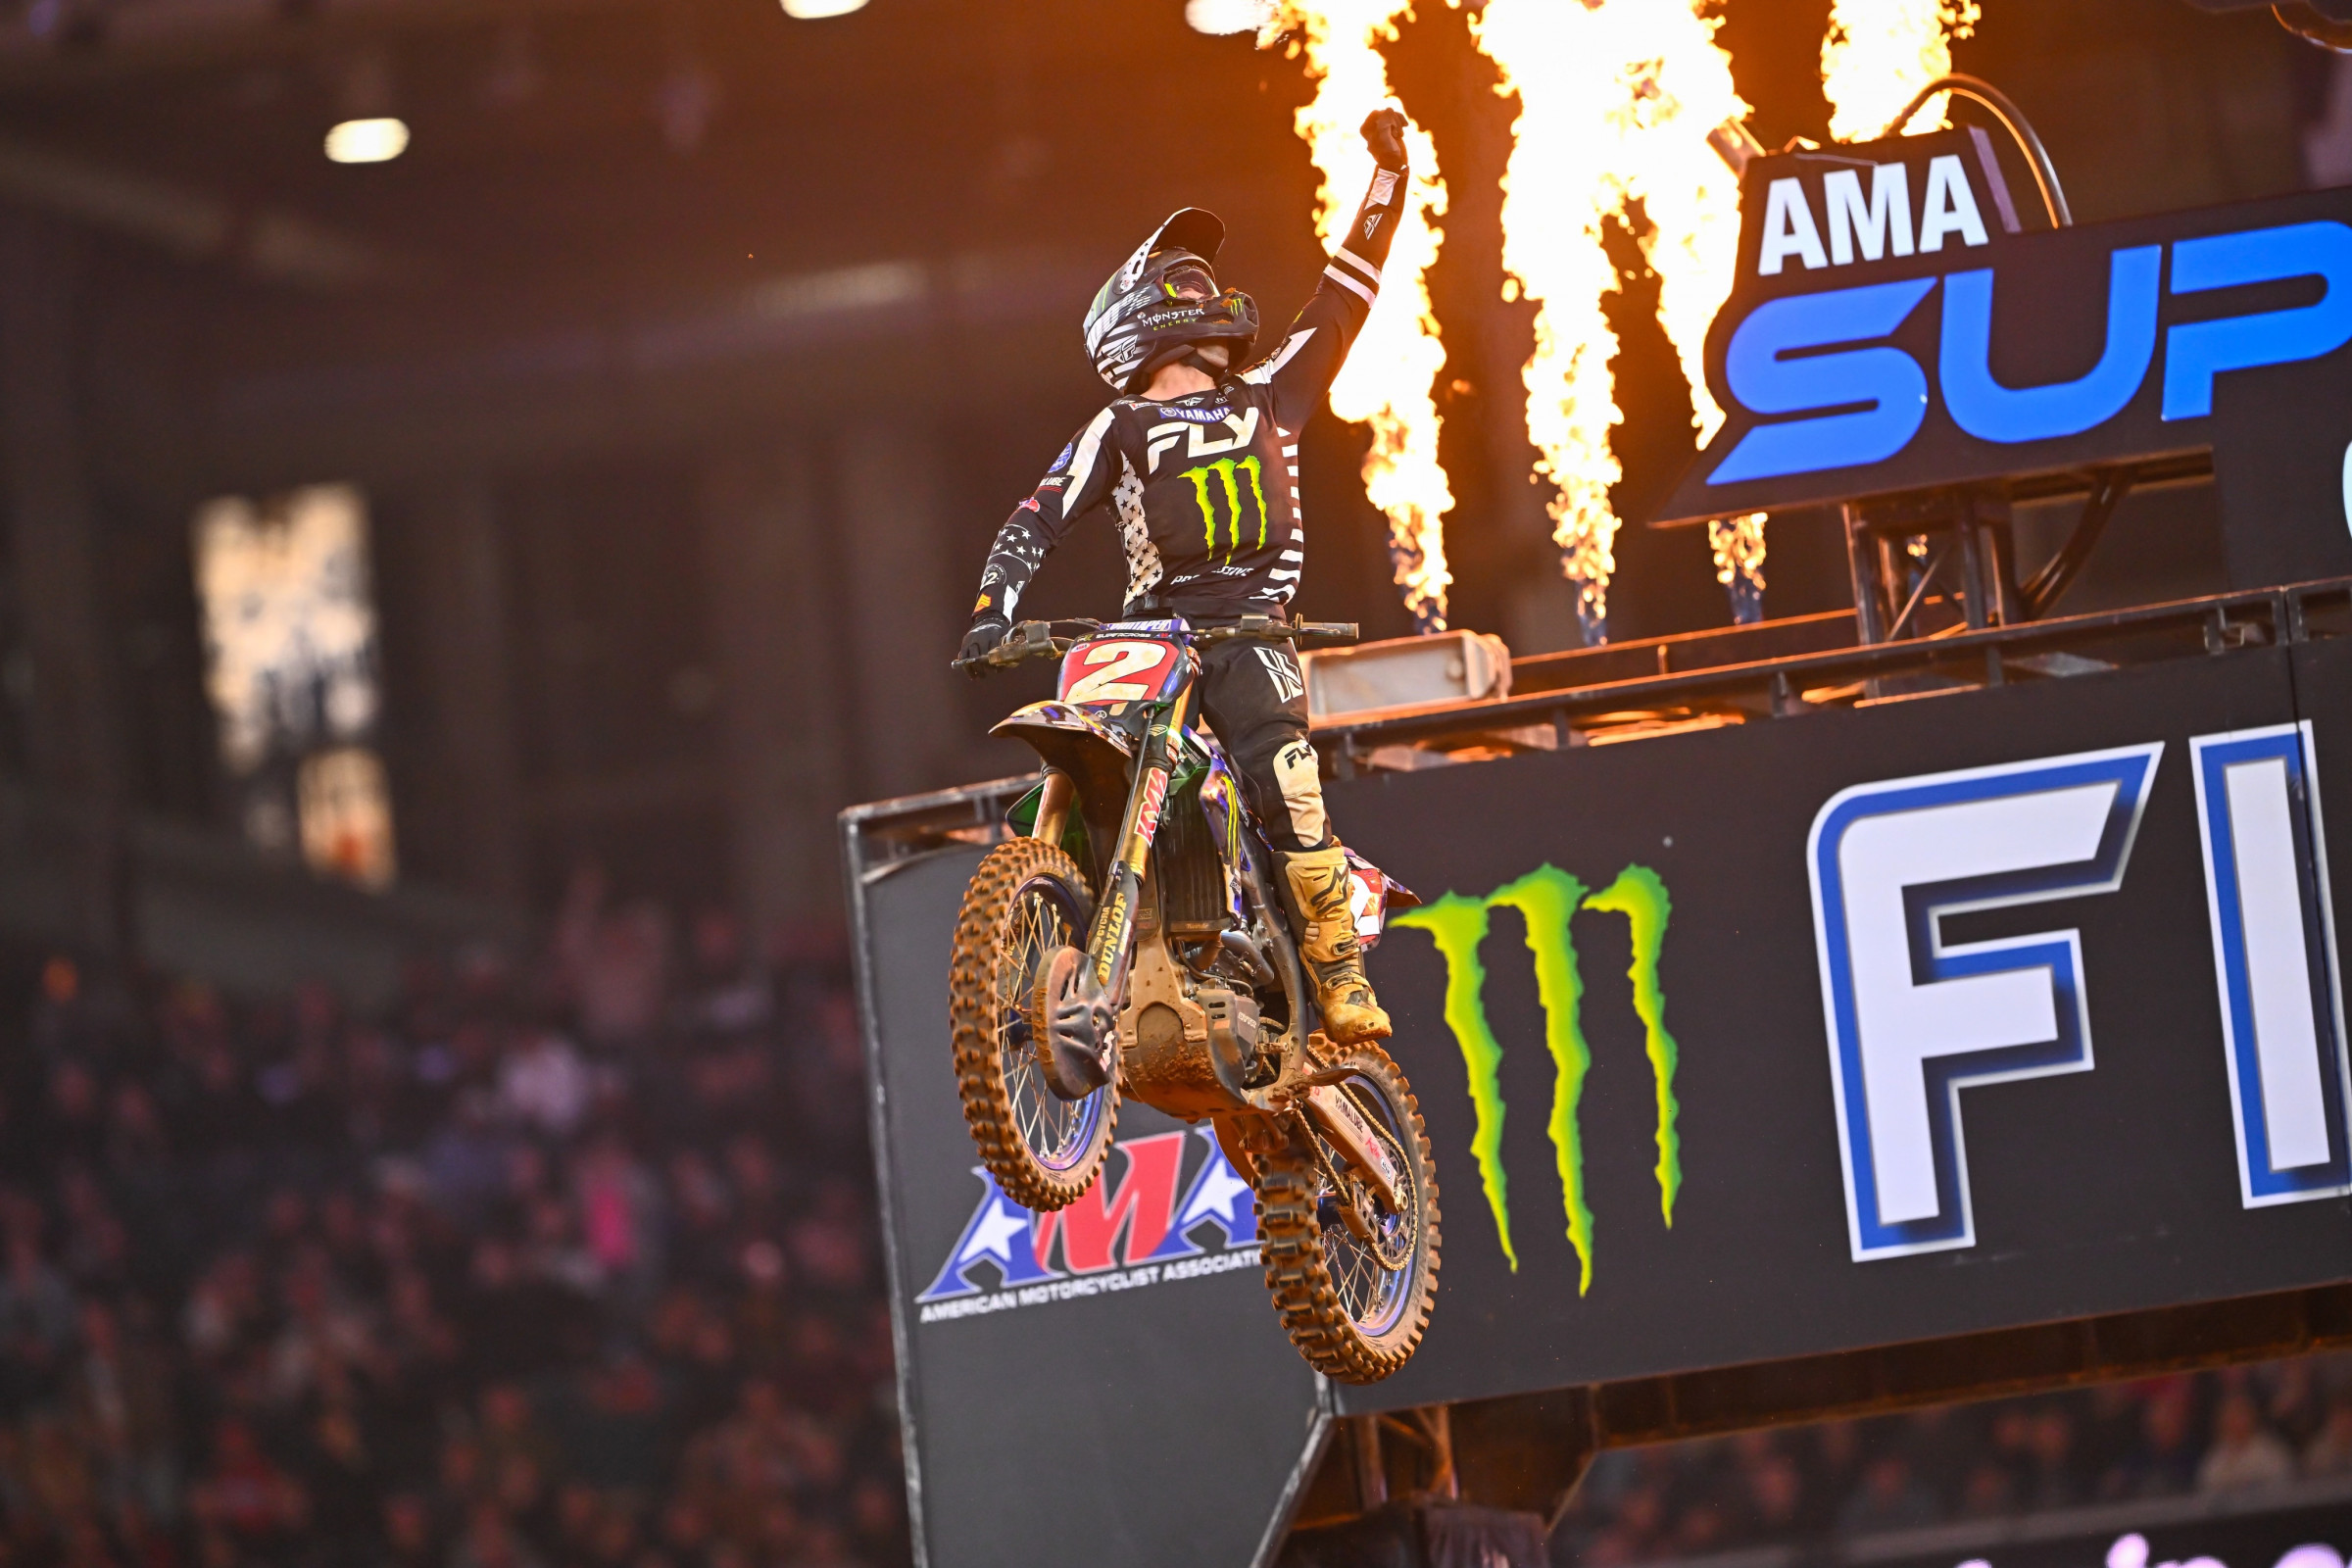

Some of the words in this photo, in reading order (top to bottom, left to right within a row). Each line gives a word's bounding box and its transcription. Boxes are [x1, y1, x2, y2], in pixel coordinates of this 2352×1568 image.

[1758, 154, 1988, 276] AMA
[1142, 308, 1205, 327] MONSTER
[1152, 318, 1198, 331] ENERGY
[1706, 220, 2352, 485] SUP
[1148, 407, 1259, 475] FLY
[1176, 407, 1231, 422] YAMAHA
[1063, 641, 1167, 706] 2
[1098, 892, 1127, 986] DUNLOP
[1806, 719, 2352, 1263] FI
[914, 1125, 1266, 1303] AMA
[919, 1289, 1017, 1323] AMERICAN
[1019, 1265, 1159, 1307] MOTORCYCLIST
[1163, 1247, 1264, 1282] ASSOCIATI
